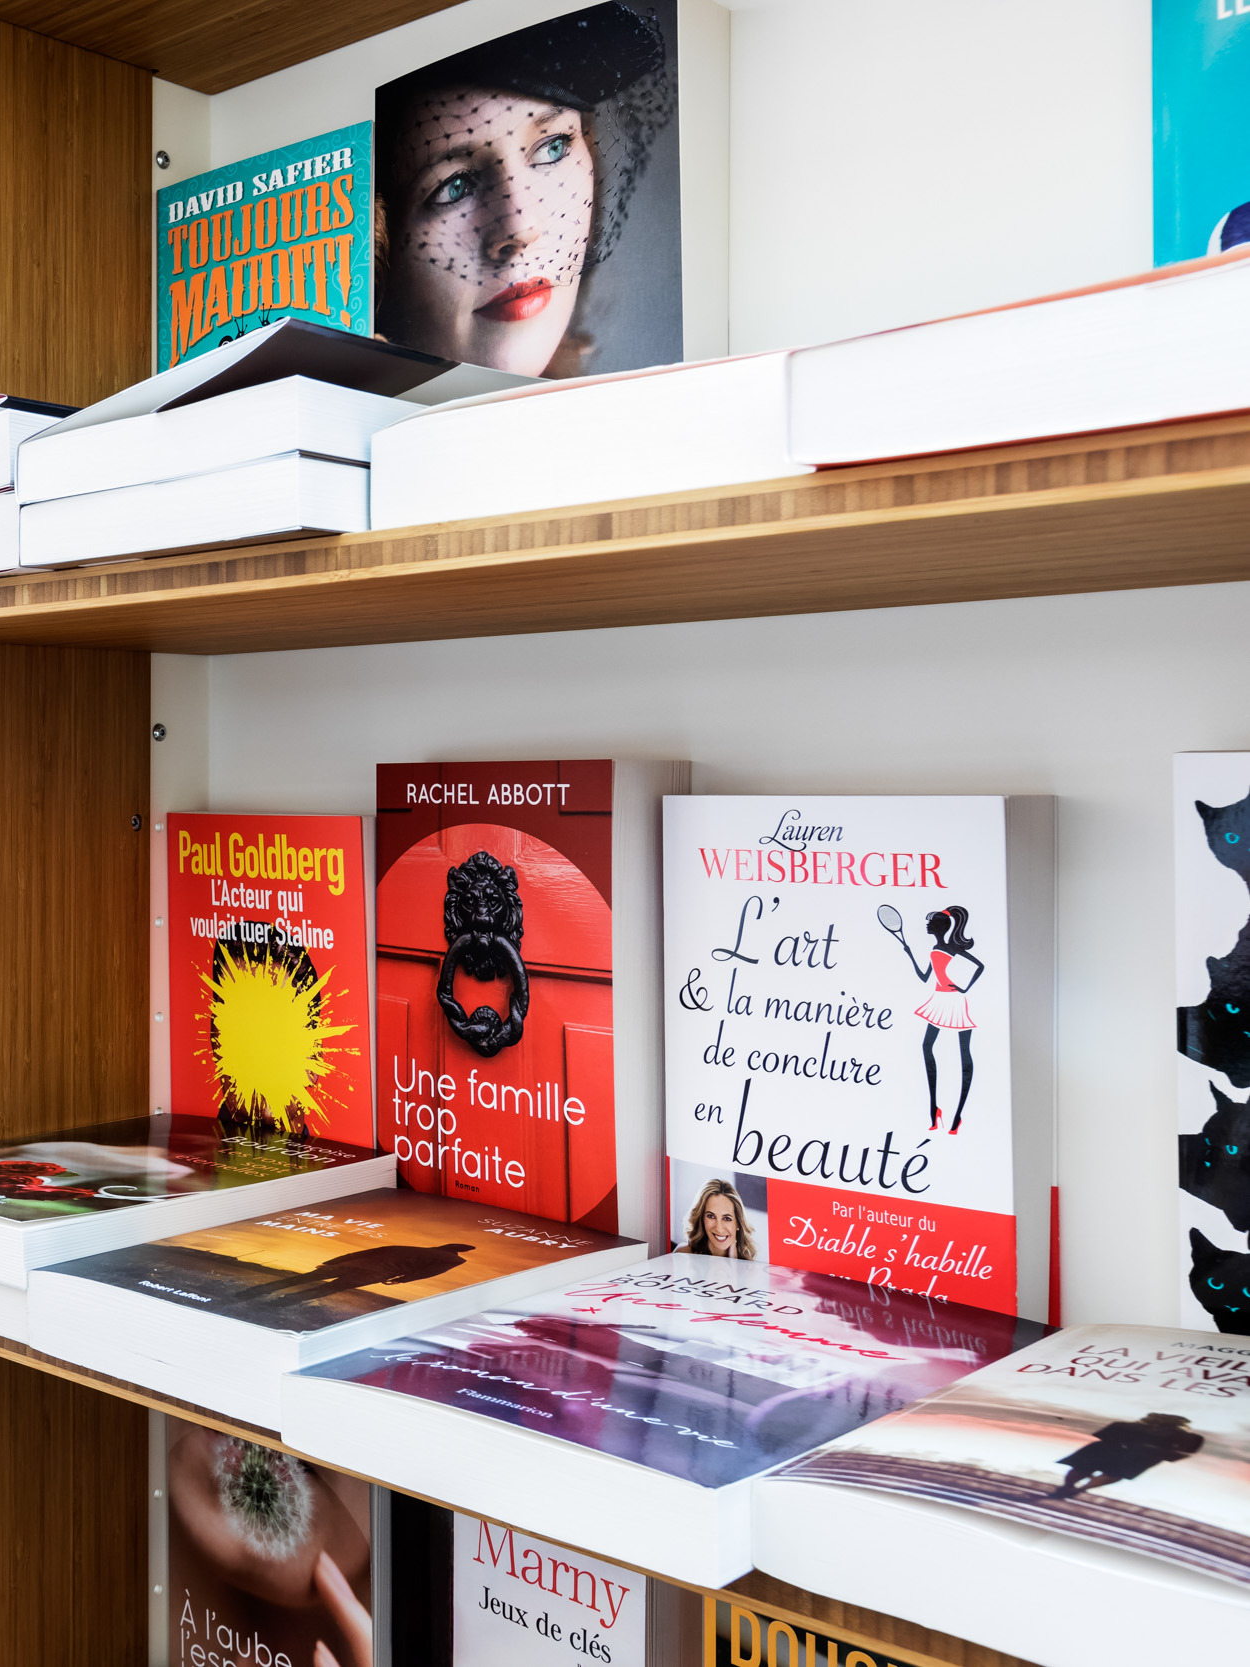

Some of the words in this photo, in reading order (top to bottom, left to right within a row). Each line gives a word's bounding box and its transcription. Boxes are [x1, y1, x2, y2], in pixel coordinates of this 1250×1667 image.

[167, 181, 244, 224] DAVID
[252, 147, 354, 197] SAFIER
[167, 174, 354, 275] TOUJOURS
[168, 233, 354, 368] MAUDIT!
[406, 784, 480, 805] RACHEL
[487, 784, 570, 806] ABBOTT
[758, 809, 843, 852] Lauren
[178, 830, 223, 877] Paul
[229, 832, 345, 896] Goldberg
[698, 847, 948, 889] WEISBERGER
[211, 878, 272, 911] L'Acteur
[277, 884, 304, 921] qui
[190, 913, 237, 942] voulait
[239, 919, 271, 944] tuer
[275, 918, 334, 950] Staline
[711, 895, 839, 970] L'art
[679, 967, 714, 1013] &
[726, 967, 753, 1016] la
[764, 990, 894, 1031] manière
[702, 1020, 736, 1069] de
[746, 1031, 883, 1086] conclure
[393, 1055, 457, 1100] Une
[467, 1069, 586, 1126] famille
[392, 1089, 457, 1145] trop
[694, 1102, 724, 1124] en
[220, 1135, 336, 1164] Bourdon
[274, 1138, 356, 1159] Françoise
[732, 1078, 932, 1195] beauté
[218, 1147, 248, 1158] Les
[252, 1154, 309, 1170] roses
[242, 1161, 291, 1174] sont
[393, 1134, 526, 1189] parfaite
[454, 1179, 481, 1194] Roman
[255, 1220, 342, 1238] MAINS
[276, 1215, 342, 1231] ENTRE
[349, 1227, 389, 1240] TES
[294, 1211, 334, 1222] MA
[344, 1218, 385, 1230] VIE
[478, 1217, 593, 1248] SUZANNE
[832, 1201, 854, 1218] Par
[858, 1205, 914, 1228] l'auteur
[918, 1216, 937, 1232] du
[484, 1228, 579, 1250] AUBRY
[783, 1216, 877, 1260] Diable
[884, 1234, 993, 1280] s'habille
[138, 1280, 174, 1293] Robert
[173, 1289, 212, 1303] Laffont
[607, 1276, 805, 1316] BOISSARD
[626, 1270, 777, 1299] JANINE
[565, 1282, 690, 1313] Une
[690, 1309, 907, 1361] femme
[1070, 1356, 1152, 1371] QUI
[1078, 1345, 1129, 1358] LA
[370, 1351, 421, 1364] le
[411, 1359, 550, 1391] roman
[551, 1390, 669, 1427] d'une
[674, 1423, 740, 1450] vie
[1016, 1363, 1148, 1383] DANS
[1160, 1378, 1242, 1398] LES
[455, 1387, 554, 1419] Flammarion
[473, 1520, 630, 1629] Marny
[180, 1588, 196, 1634] À
[206, 1608, 292, 1667] l'aube
[478, 1586, 529, 1628] Jeux
[536, 1612, 562, 1642] de
[569, 1627, 612, 1664] clés
